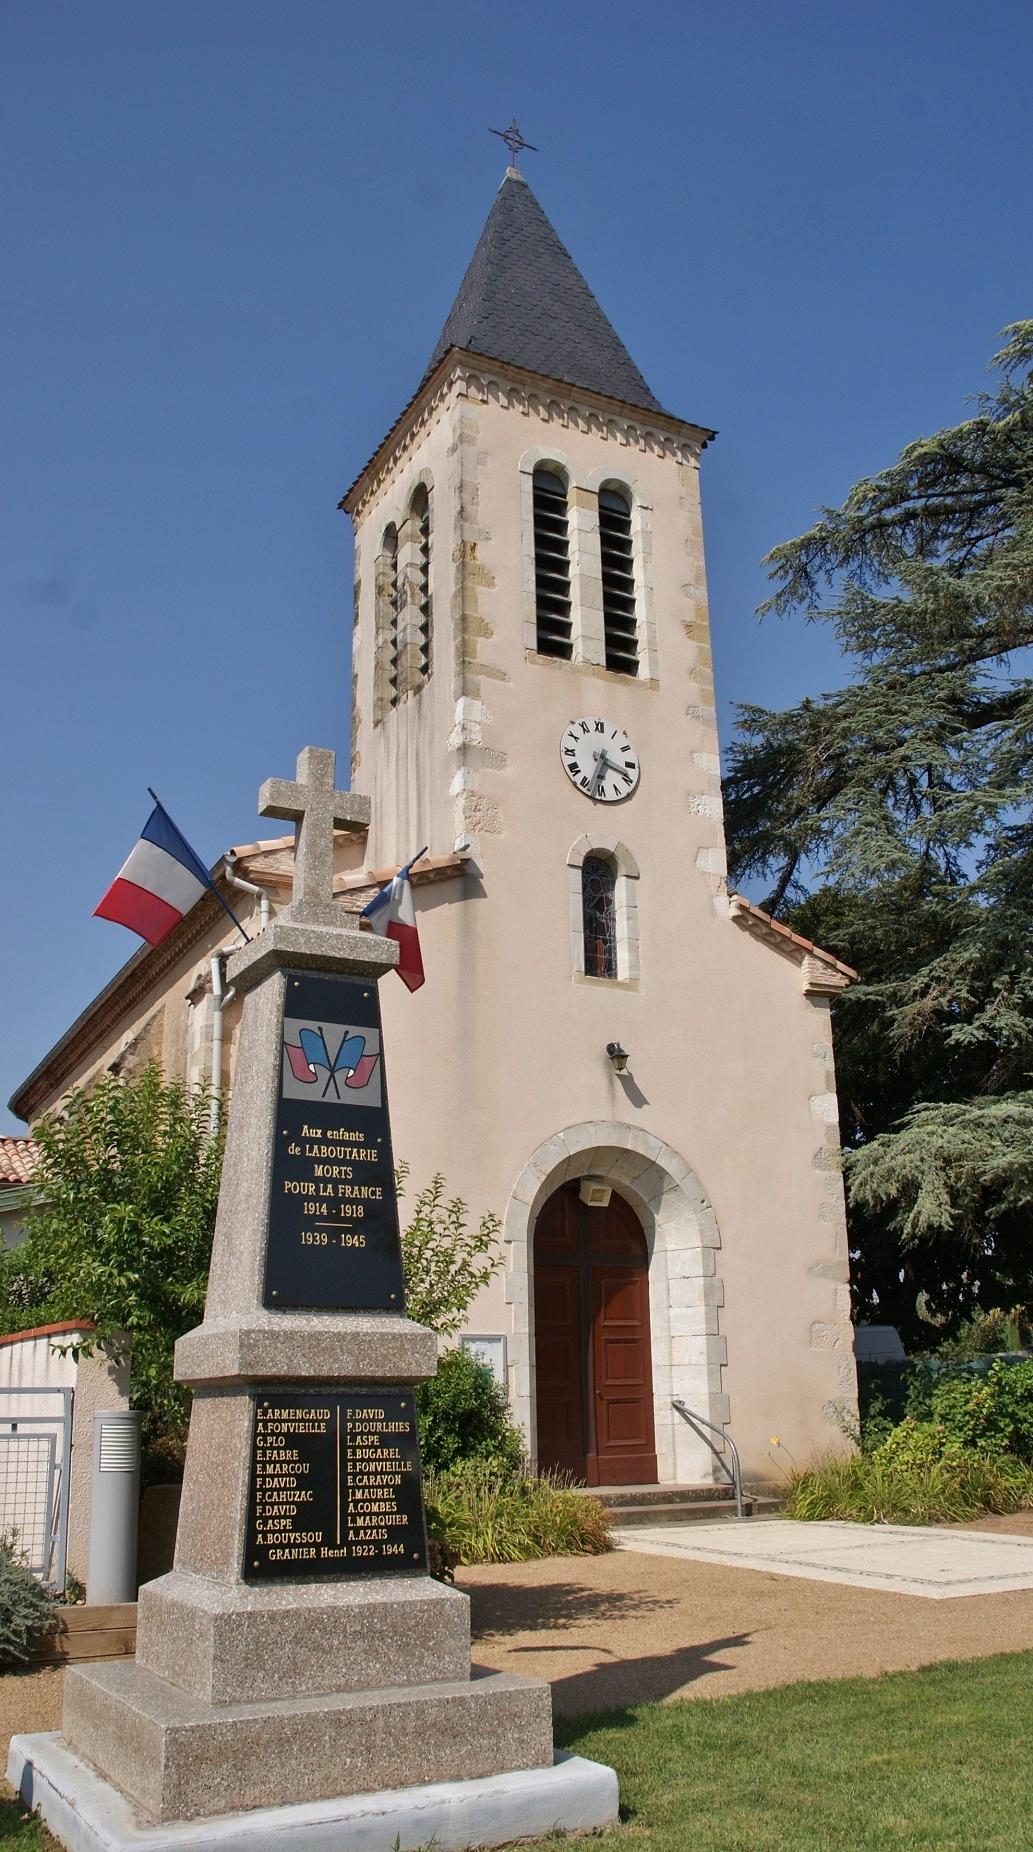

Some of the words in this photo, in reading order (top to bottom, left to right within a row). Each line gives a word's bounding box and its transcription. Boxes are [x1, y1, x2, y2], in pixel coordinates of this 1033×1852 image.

[578, 720, 590, 734] XI
[594, 720, 605, 734] XII
[568, 731, 580, 742] X
[564, 746, 576, 757] IX
[567, 762, 581, 776] VIII
[613, 784, 622, 796] V
[301, 1124, 322, 1138] Aux
[327, 1128, 365, 1142] enfants
[288, 1142, 301, 1156] de
[305, 1144, 378, 1162] LABOUTARIE
[314, 1164, 353, 1179] MORTS
[284, 1181, 316, 1195] POUR
[319, 1183, 334, 1197] LA
[338, 1185, 383, 1200] FRANCE
[303, 1202, 328, 1216] 1914
[340, 1204, 364, 1218] 1918
[300, 1232, 328, 1246] 1939
[340, 1234, 366, 1248] 1945
[256, 1408, 331, 1420] E.ARMENGAUD
[346, 1408, 385, 1420] F.DAVID
[256, 1422, 327, 1433] A.FONVIEILLE
[346, 1421, 410, 1433] P.DOURLHIES
[256, 1436, 286, 1447] G.PLO
[346, 1435, 380, 1446] L.ASPE
[256, 1449, 299, 1461] E.FABRE
[346, 1448, 401, 1460] E.BUGAREL
[256, 1463, 310, 1475] E.MARCOU
[346, 1461, 413, 1473] E.FONVIEILLE
[256, 1477, 297, 1488] F.DAVID
[347, 1474, 402, 1487] E.CARAYON
[256, 1490, 314, 1502] F.CAHUZAC
[347, 1488, 396, 1502] J.MAUREL
[256, 1505, 297, 1517] F.DAVID
[347, 1501, 398, 1514] A.COMBES
[256, 1518, 293, 1531] G.ASPE
[347, 1514, 409, 1528] L.MARQUIER
[255, 1531, 322, 1545] A.BOUYSSOU
[347, 1528, 388, 1541] A.AZAIS
[268, 1546, 317, 1561] GRANIER
[320, 1546, 347, 1558] Henri
[382, 1544, 405, 1556] 1944
